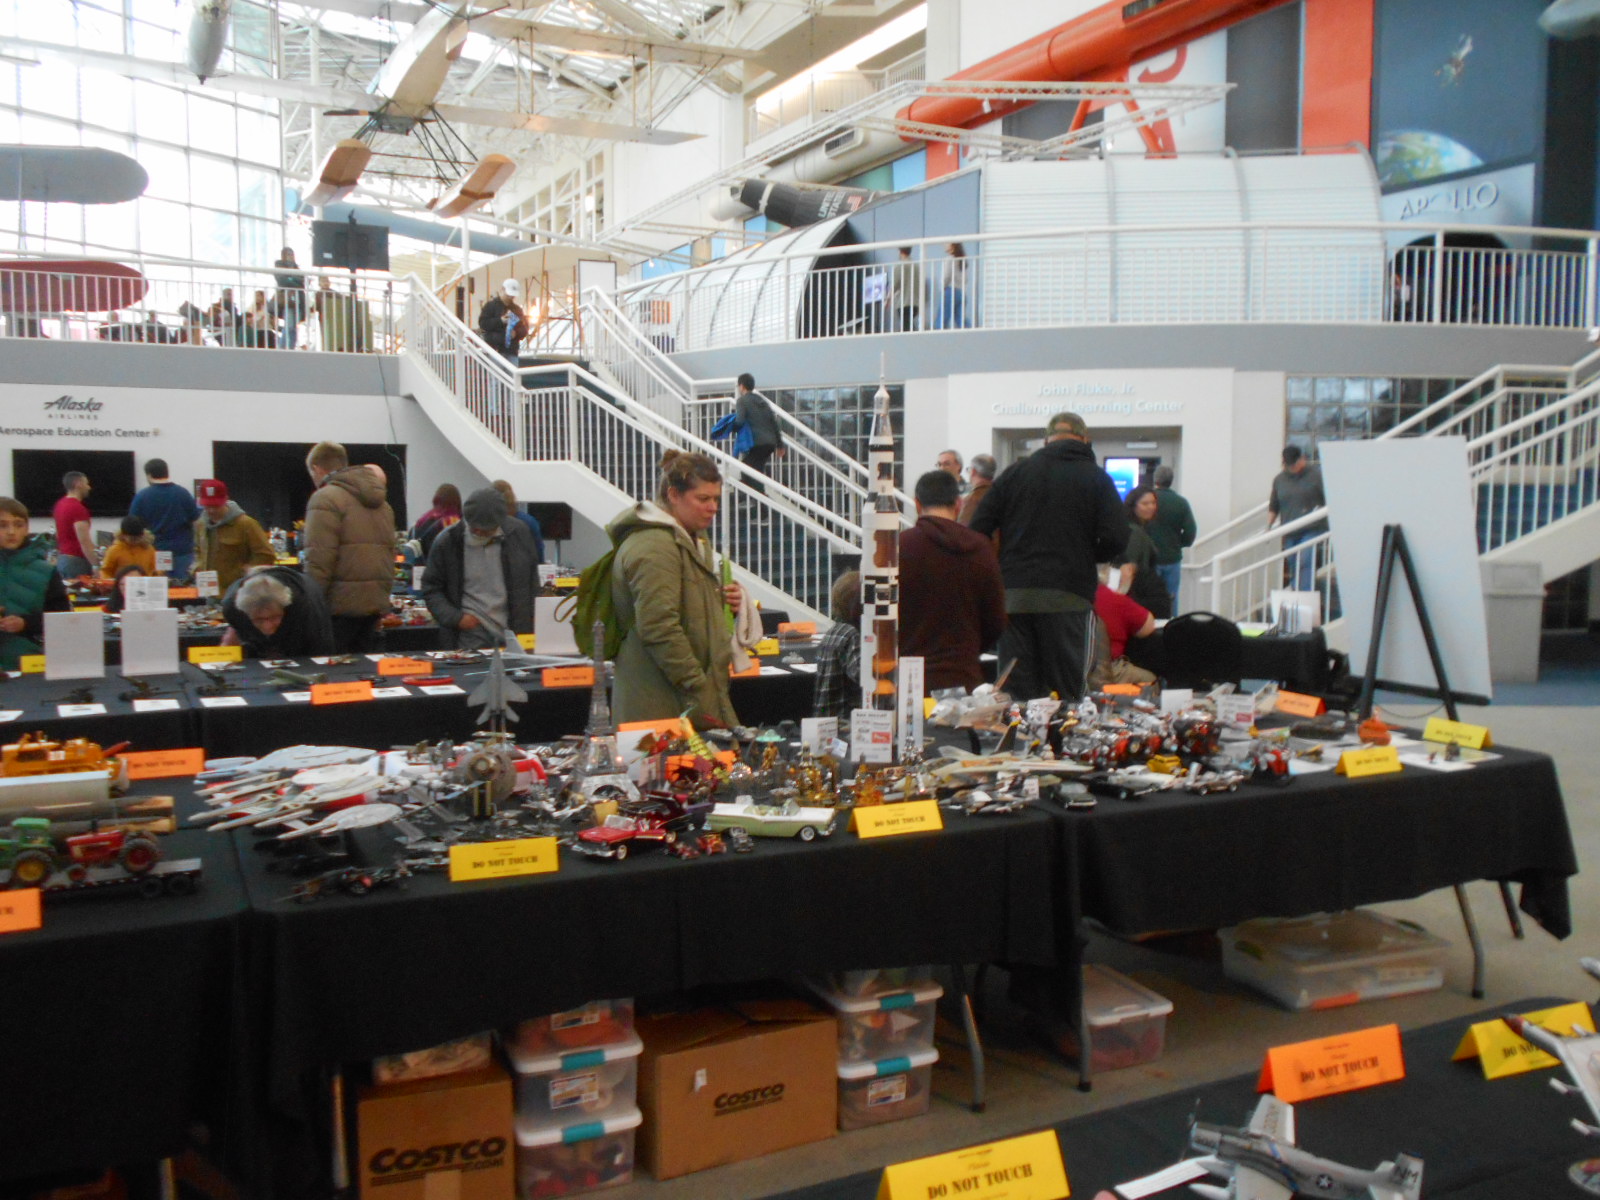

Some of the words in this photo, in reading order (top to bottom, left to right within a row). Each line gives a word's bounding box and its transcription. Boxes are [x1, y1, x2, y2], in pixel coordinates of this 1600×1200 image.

[1038, 384, 1070, 397] John
[43, 395, 104, 412] Alaska
[991, 401, 1066, 417] Challenger
[1070, 400, 1133, 416] Learning
[1134, 400, 1185, 412] Center
[0, 426, 54, 438] Aerospace
[57, 427, 112, 437] Education
[114, 428, 150, 438] Center
[472, 861, 485, 869] DO
[488, 858, 506, 867] NOT
[508, 855, 539, 865] TOUCH
[1300, 1069, 1316, 1083] DO
[1318, 1063, 1340, 1078] NOT
[1342, 1055, 1379, 1075] TOUCH
[714, 1083, 785, 1109] COSTCO
[369, 1136, 506, 1174] COSTCO
[927, 1183, 948, 1200] DO
[951, 1174, 981, 1194] NOT
[984, 1163, 1034, 1187] TOUCH
